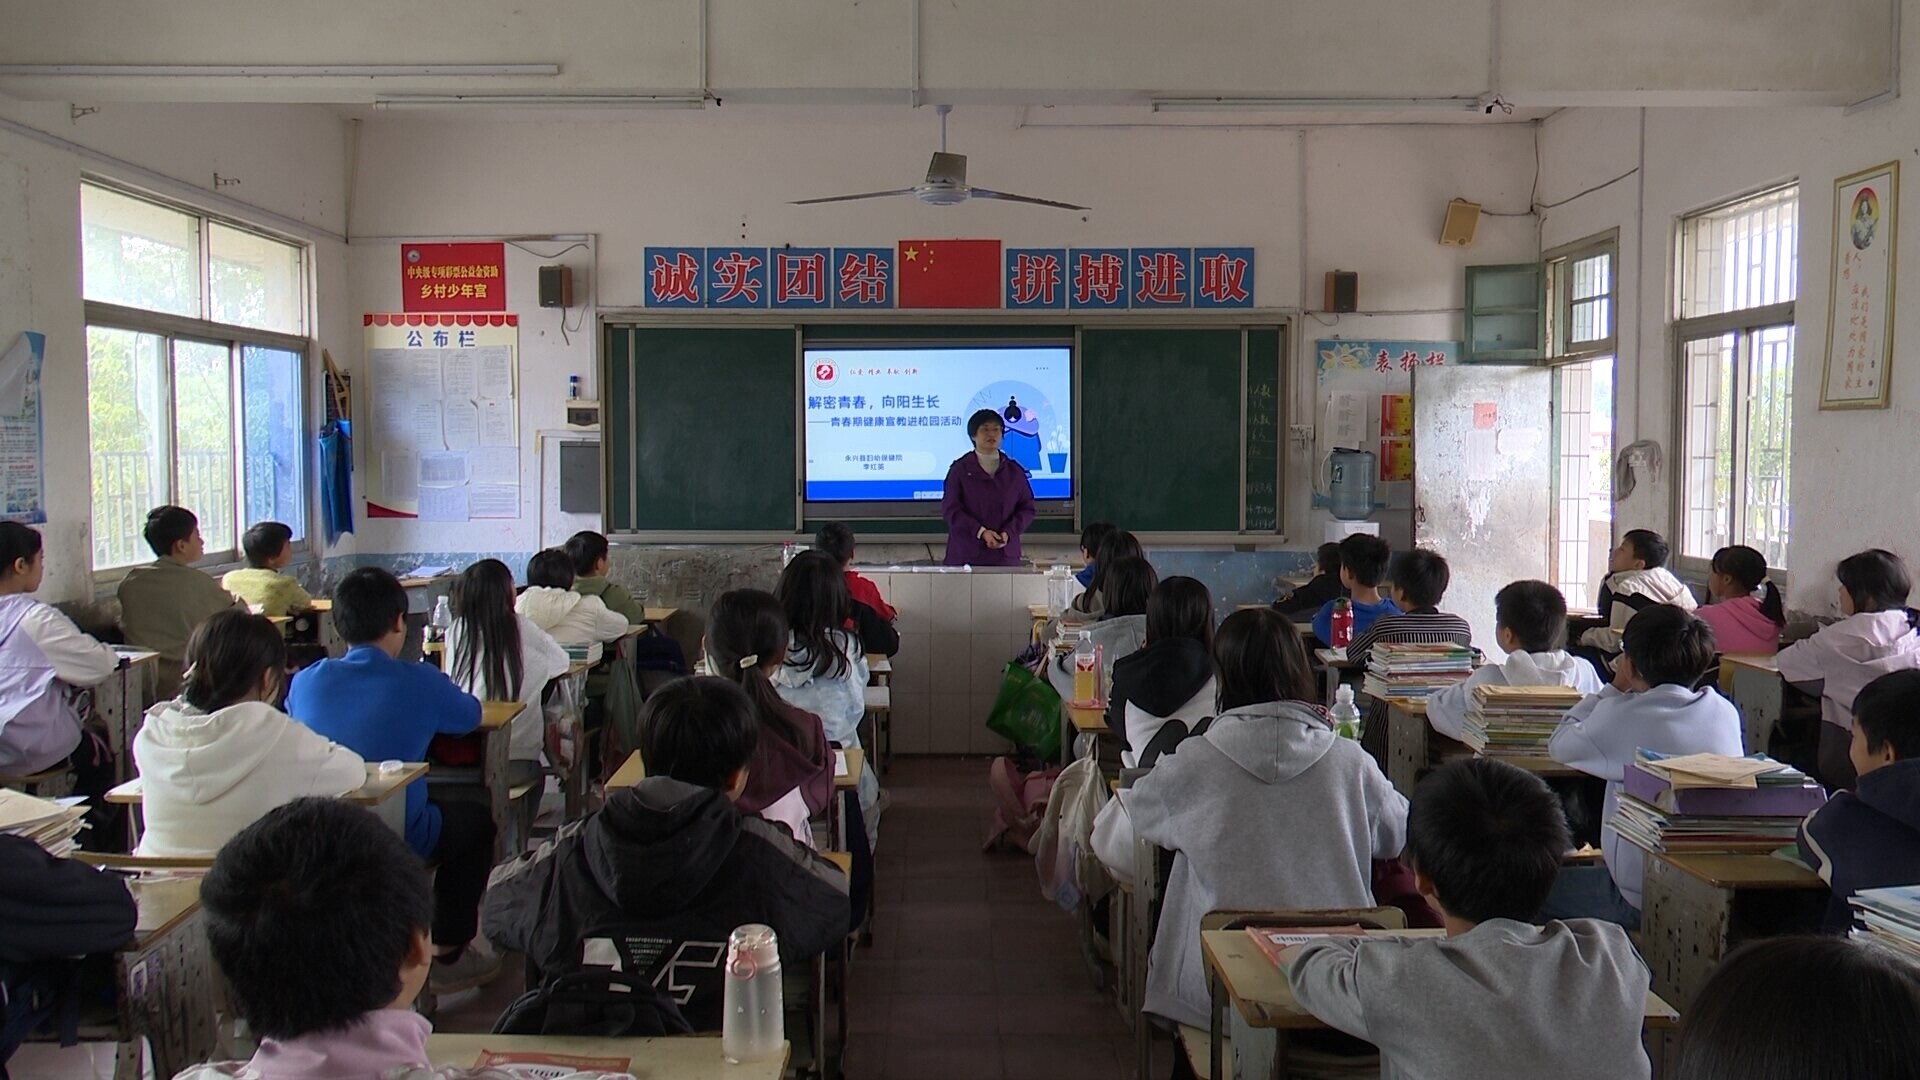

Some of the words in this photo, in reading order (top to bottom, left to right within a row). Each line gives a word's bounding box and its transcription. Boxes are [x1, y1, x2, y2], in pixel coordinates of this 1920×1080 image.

[407, 265, 499, 279] 中央级专项彩票公益金资助
[649, 252, 889, 304] 诚实团结
[1011, 253, 1249, 304] 拼搏进取
[421, 284, 487, 299] 乡村少年宫
[407, 330, 475, 347] 公布栏
[1375, 350, 1445, 373] 表扬栏
[808, 395, 940, 410] 解密青春，向阳生长
